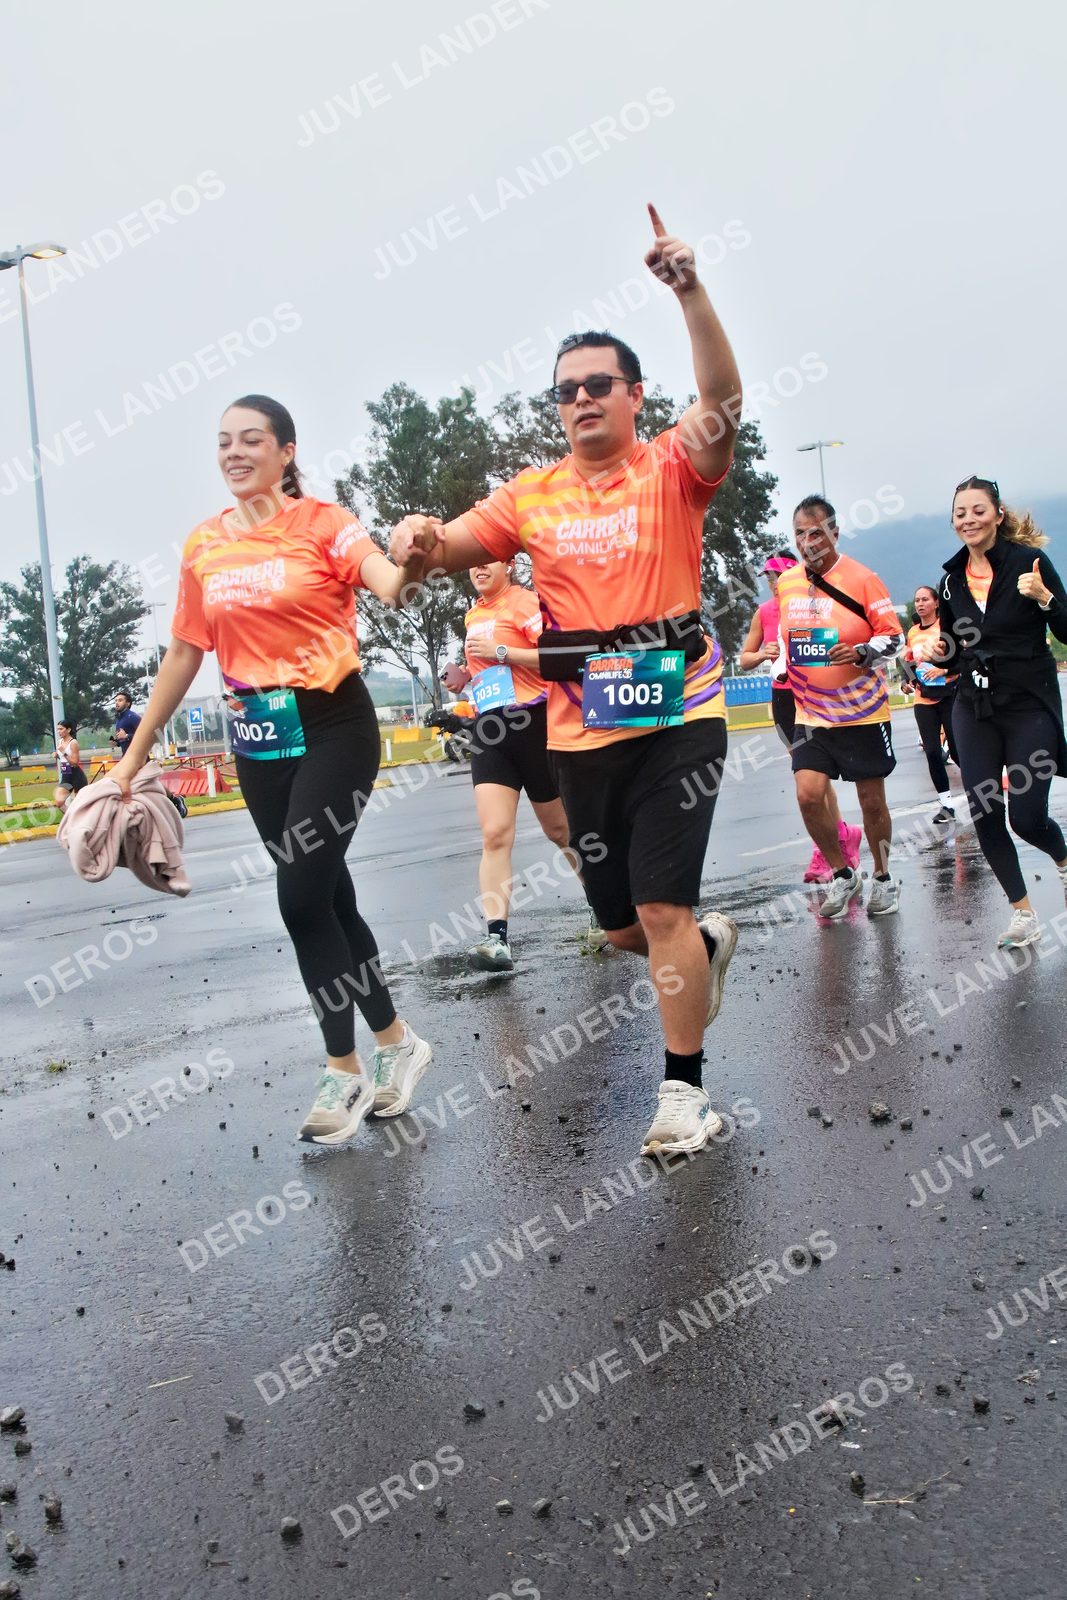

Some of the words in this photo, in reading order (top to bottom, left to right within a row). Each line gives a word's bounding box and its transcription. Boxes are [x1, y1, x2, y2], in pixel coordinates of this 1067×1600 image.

[556, 505, 637, 540] CARRERA
[556, 534, 623, 556] OMNILIFE
[208, 558, 286, 592] CARRERA
[207, 581, 269, 605] OMNILIFE
[797, 644, 826, 656] 1065
[588, 658, 633, 672] CARRERA
[660, 657, 678, 672] 10K
[588, 671, 623, 681] OMNILIFE
[268, 695, 287, 711] 10K
[603, 683, 663, 706] 1003
[233, 721, 278, 742] 1002
